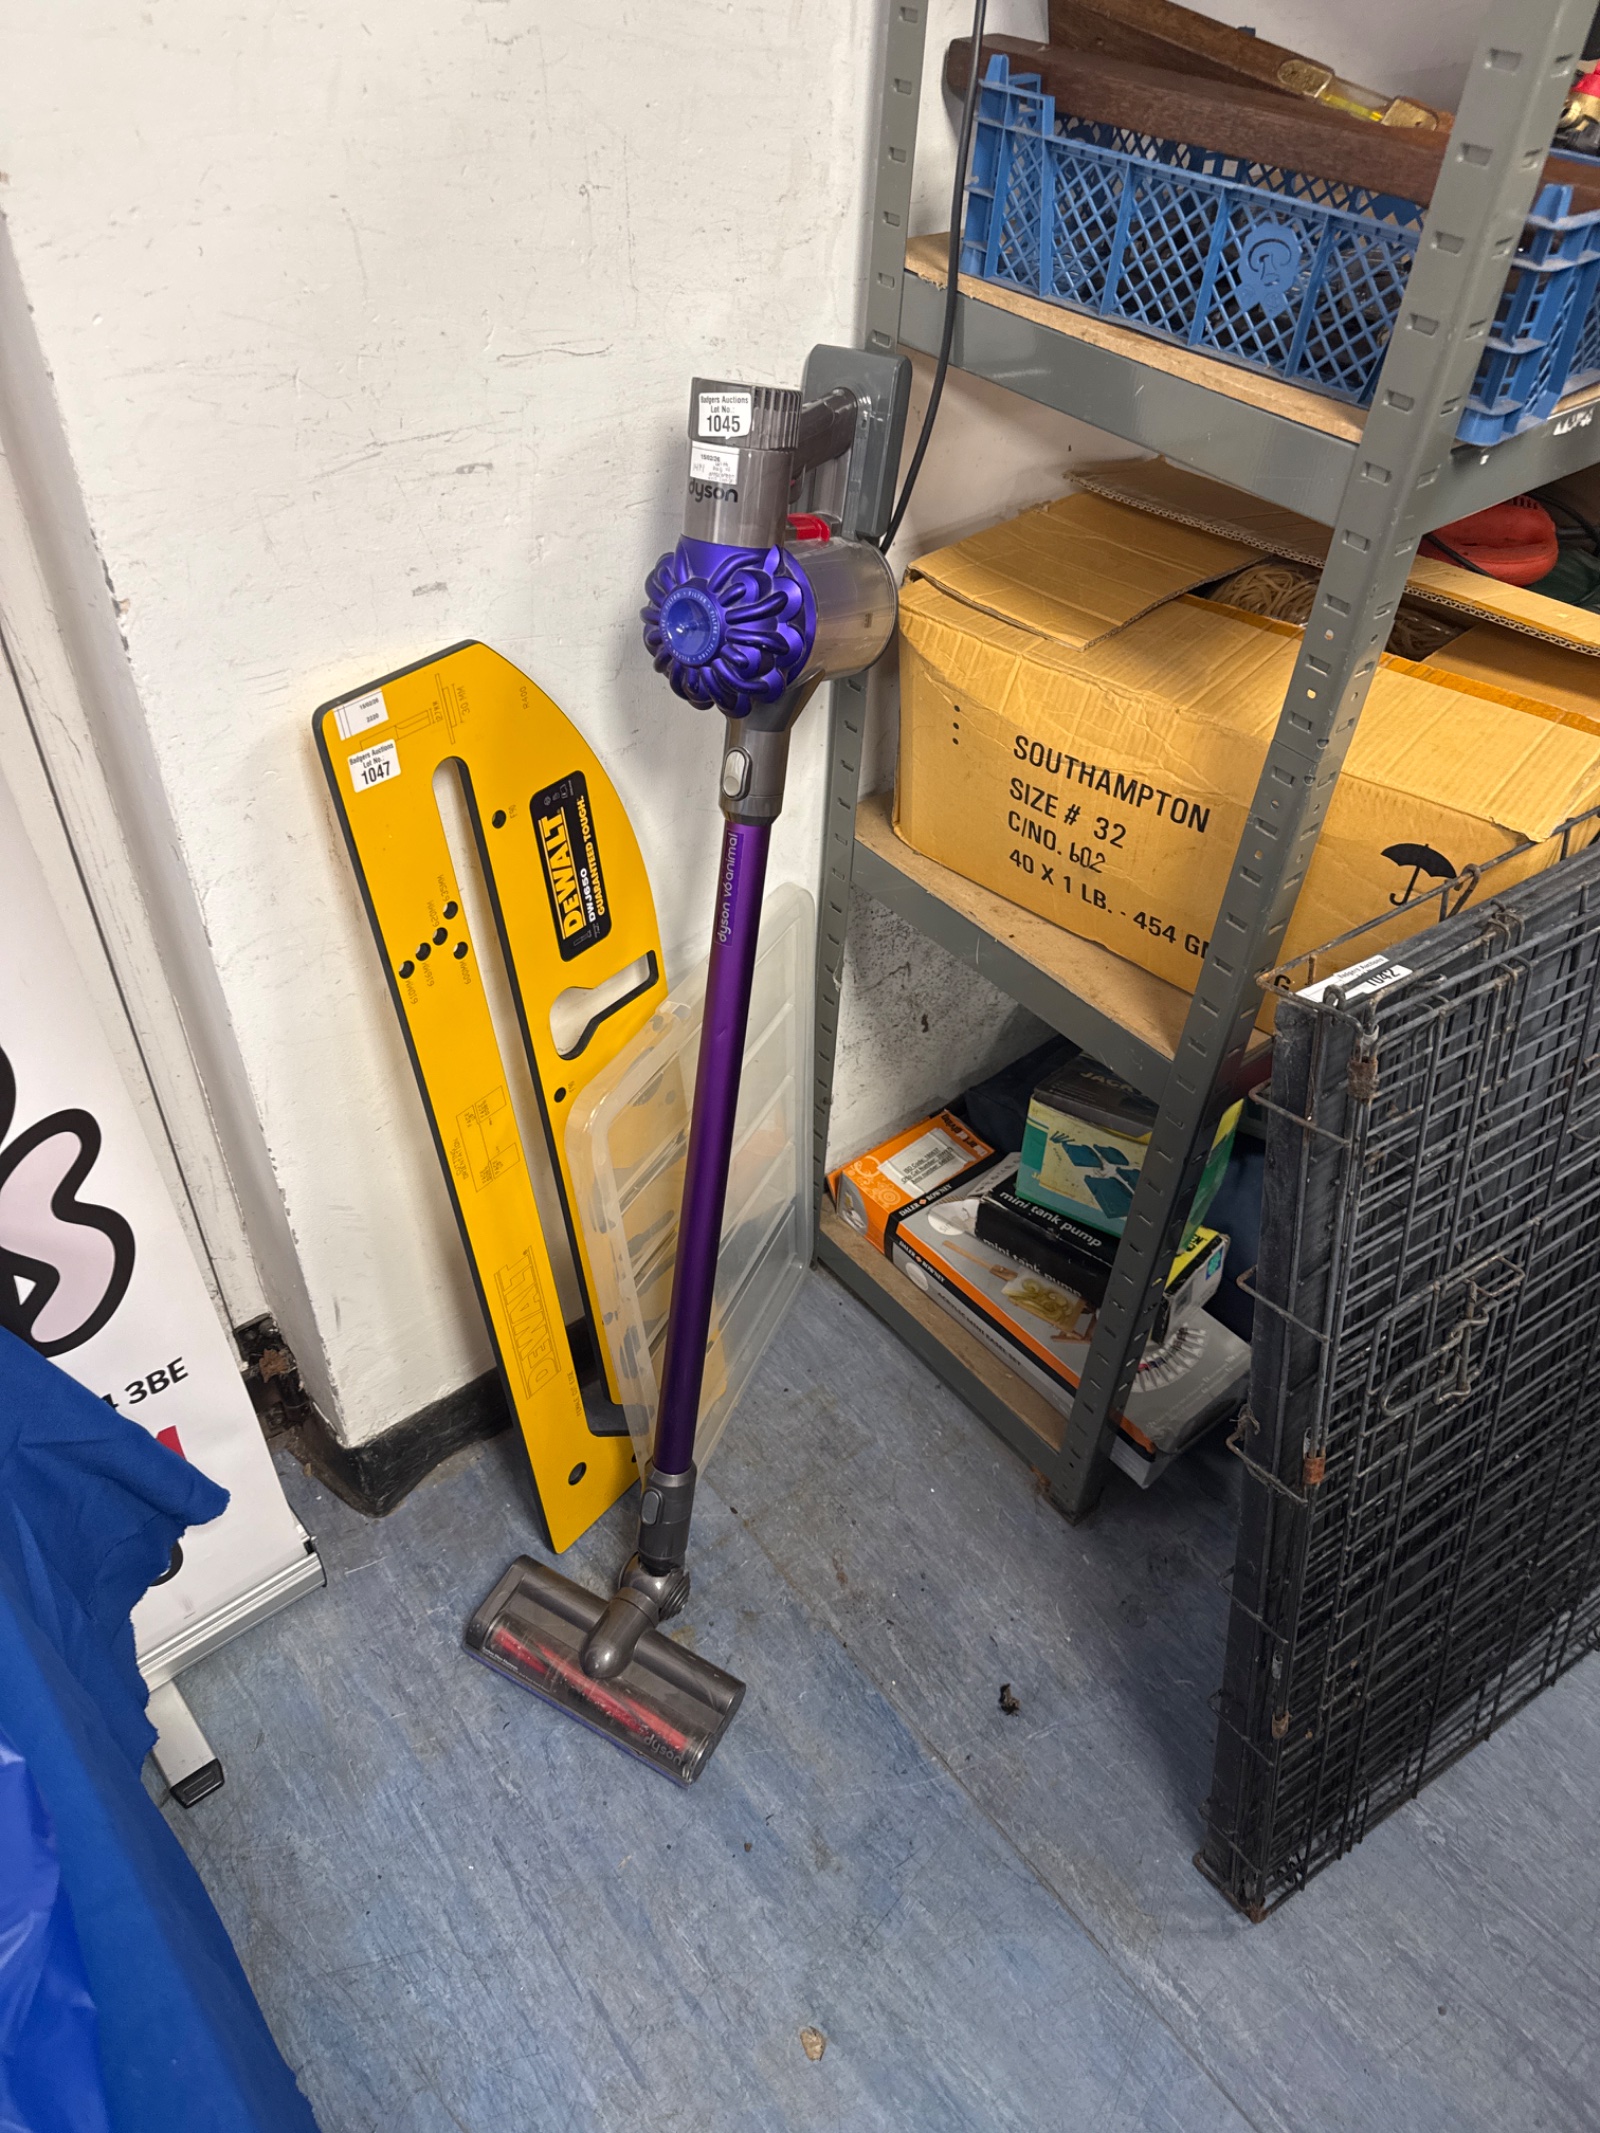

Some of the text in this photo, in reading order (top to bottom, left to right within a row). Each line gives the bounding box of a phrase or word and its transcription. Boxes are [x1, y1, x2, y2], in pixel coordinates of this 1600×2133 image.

[722, 395, 749, 404] Auctions
[707, 415, 740, 432] 1045
[689, 479, 738, 503] dyson
[460, 703, 470, 715] 30
[349, 743, 394, 765] Badgers Auctions
[361, 761, 390, 785] 1047
[362, 758, 373, 768] Lot
[1013, 735, 1211, 833] SOUTHAMPTON
[576, 795, 592, 843] TOUGH.
[1009, 777, 1126, 849] SIZE # 32
[1008, 810, 1106, 873] C/NO. 602
[541, 812, 584, 938] DEWALT
[580, 867, 596, 922] DWJ650
[585, 842, 605, 916] GUARANTEED
[717, 833, 738, 943] dyson v6 animal
[1009, 849, 1034, 874] 40
[1041, 864, 1054, 886] X
[1063, 875, 1072, 893] 1
[1081, 884, 1113, 914] LB.
[1133, 911, 1176, 943] 454
[1361, 956, 1385, 970] Auctions
[899, 1184, 953, 1217] DALER ROWNEY
[1000, 1191, 1102, 1247] mini tank pump
[899, 1240, 945, 1283] DALER ROWNEY
[983, 1238, 1010, 1256] mini
[1013, 1254, 1041, 1274] tank
[124, 1356, 189, 1404] 3BE
[644, 1733, 682, 1766] dyson
